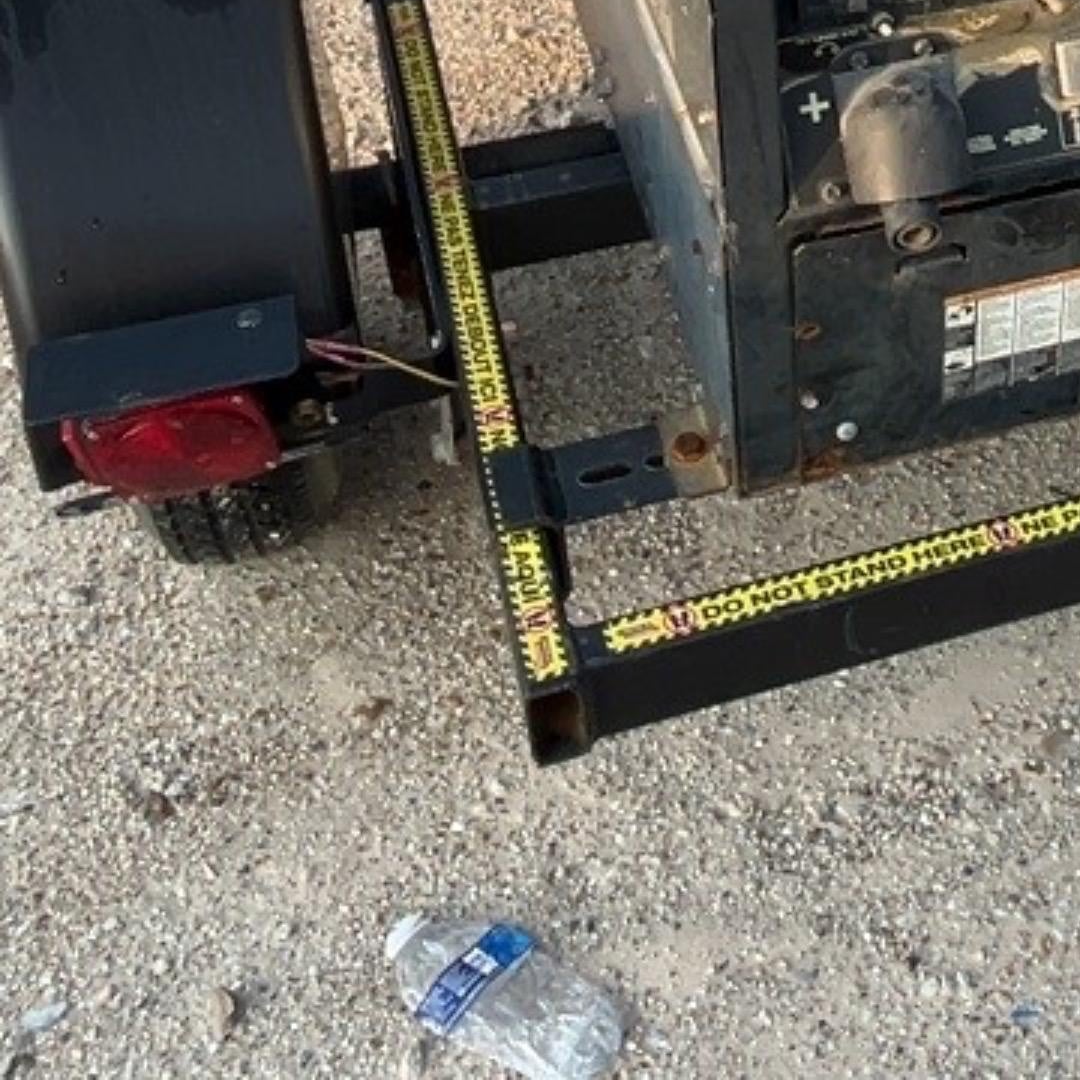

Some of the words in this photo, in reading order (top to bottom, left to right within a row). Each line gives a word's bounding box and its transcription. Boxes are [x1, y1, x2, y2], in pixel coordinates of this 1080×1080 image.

[444, 216, 464, 245] PAS
[450, 249, 476, 301] TENEZ
[462, 303, 491, 377] DEBOUT
[478, 377, 499, 402] ICI
[702, 596, 744, 620] DO
[750, 581, 808, 606] NOT
[814, 553, 909, 589] STAND
[913, 534, 988, 564] HERE
[1022, 515, 1059, 535] NE
